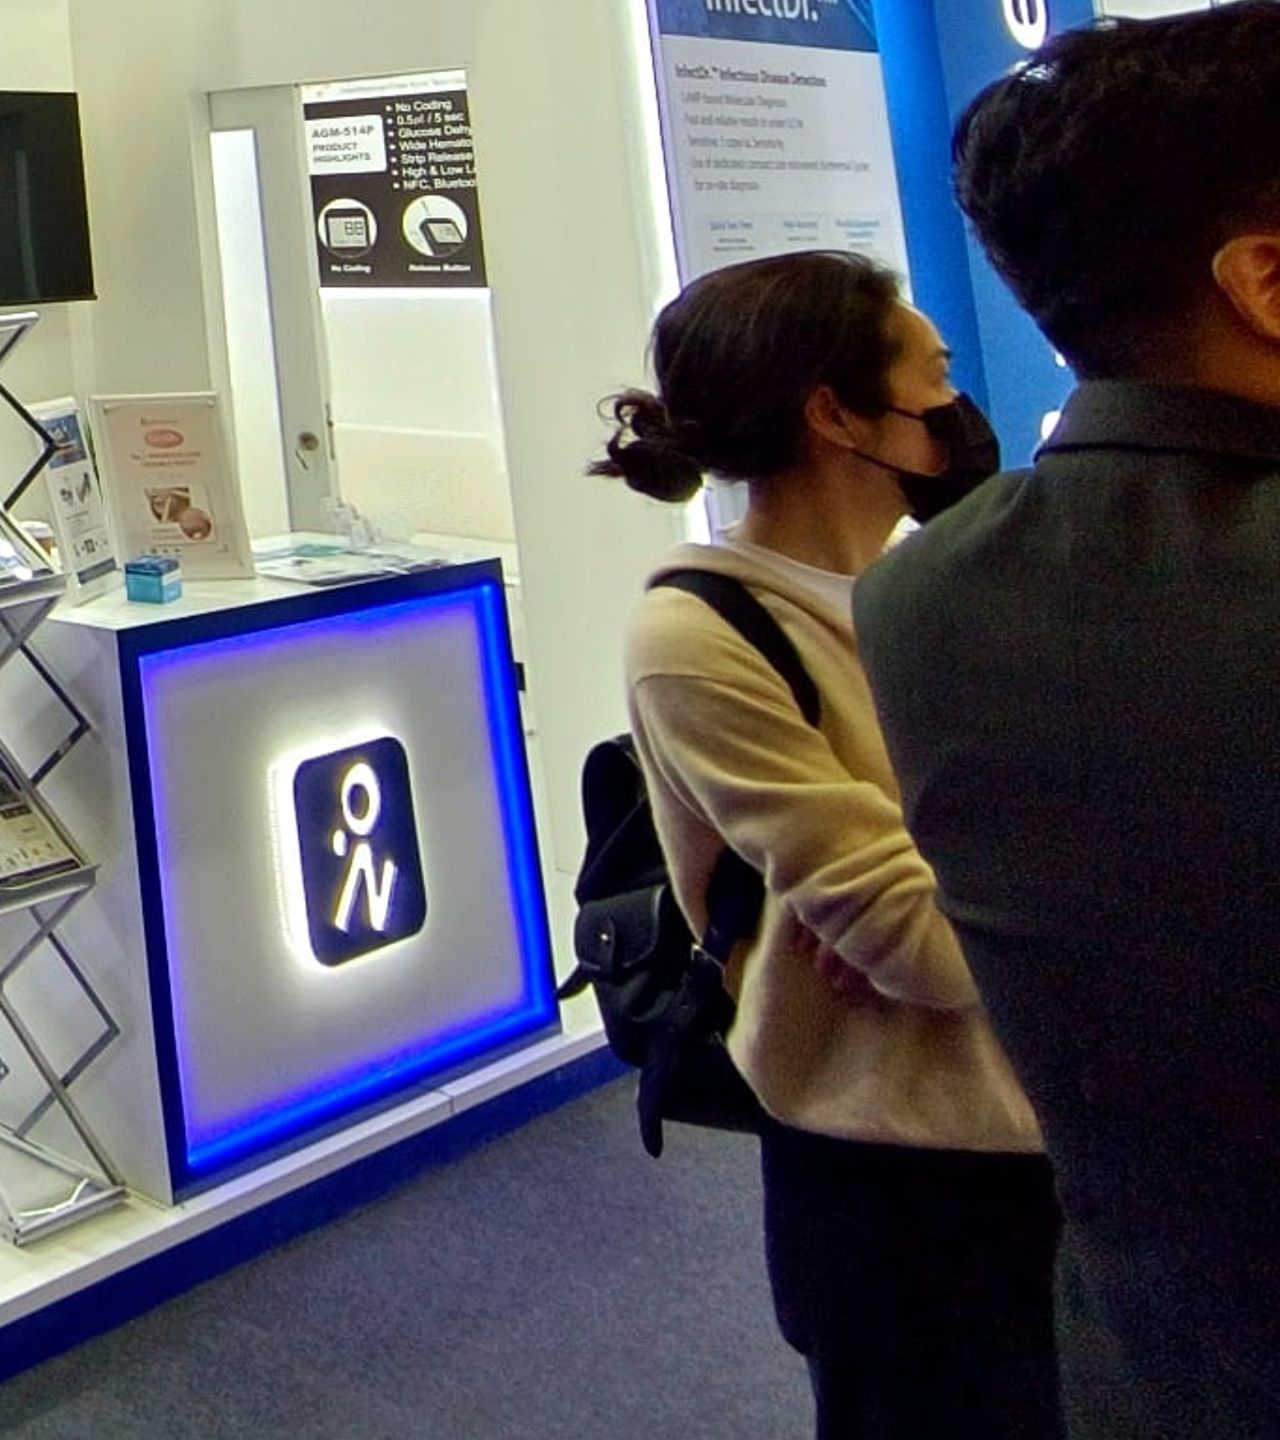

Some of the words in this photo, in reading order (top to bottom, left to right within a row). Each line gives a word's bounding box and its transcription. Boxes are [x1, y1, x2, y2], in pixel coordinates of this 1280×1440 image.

[395, 103, 411, 112] No
[414, 100, 452, 112] Coding
[434, 112, 442, 123] 5
[399, 127, 442, 138] Glucose
[430, 165, 438, 175] &
[440, 165, 463, 175] Low
